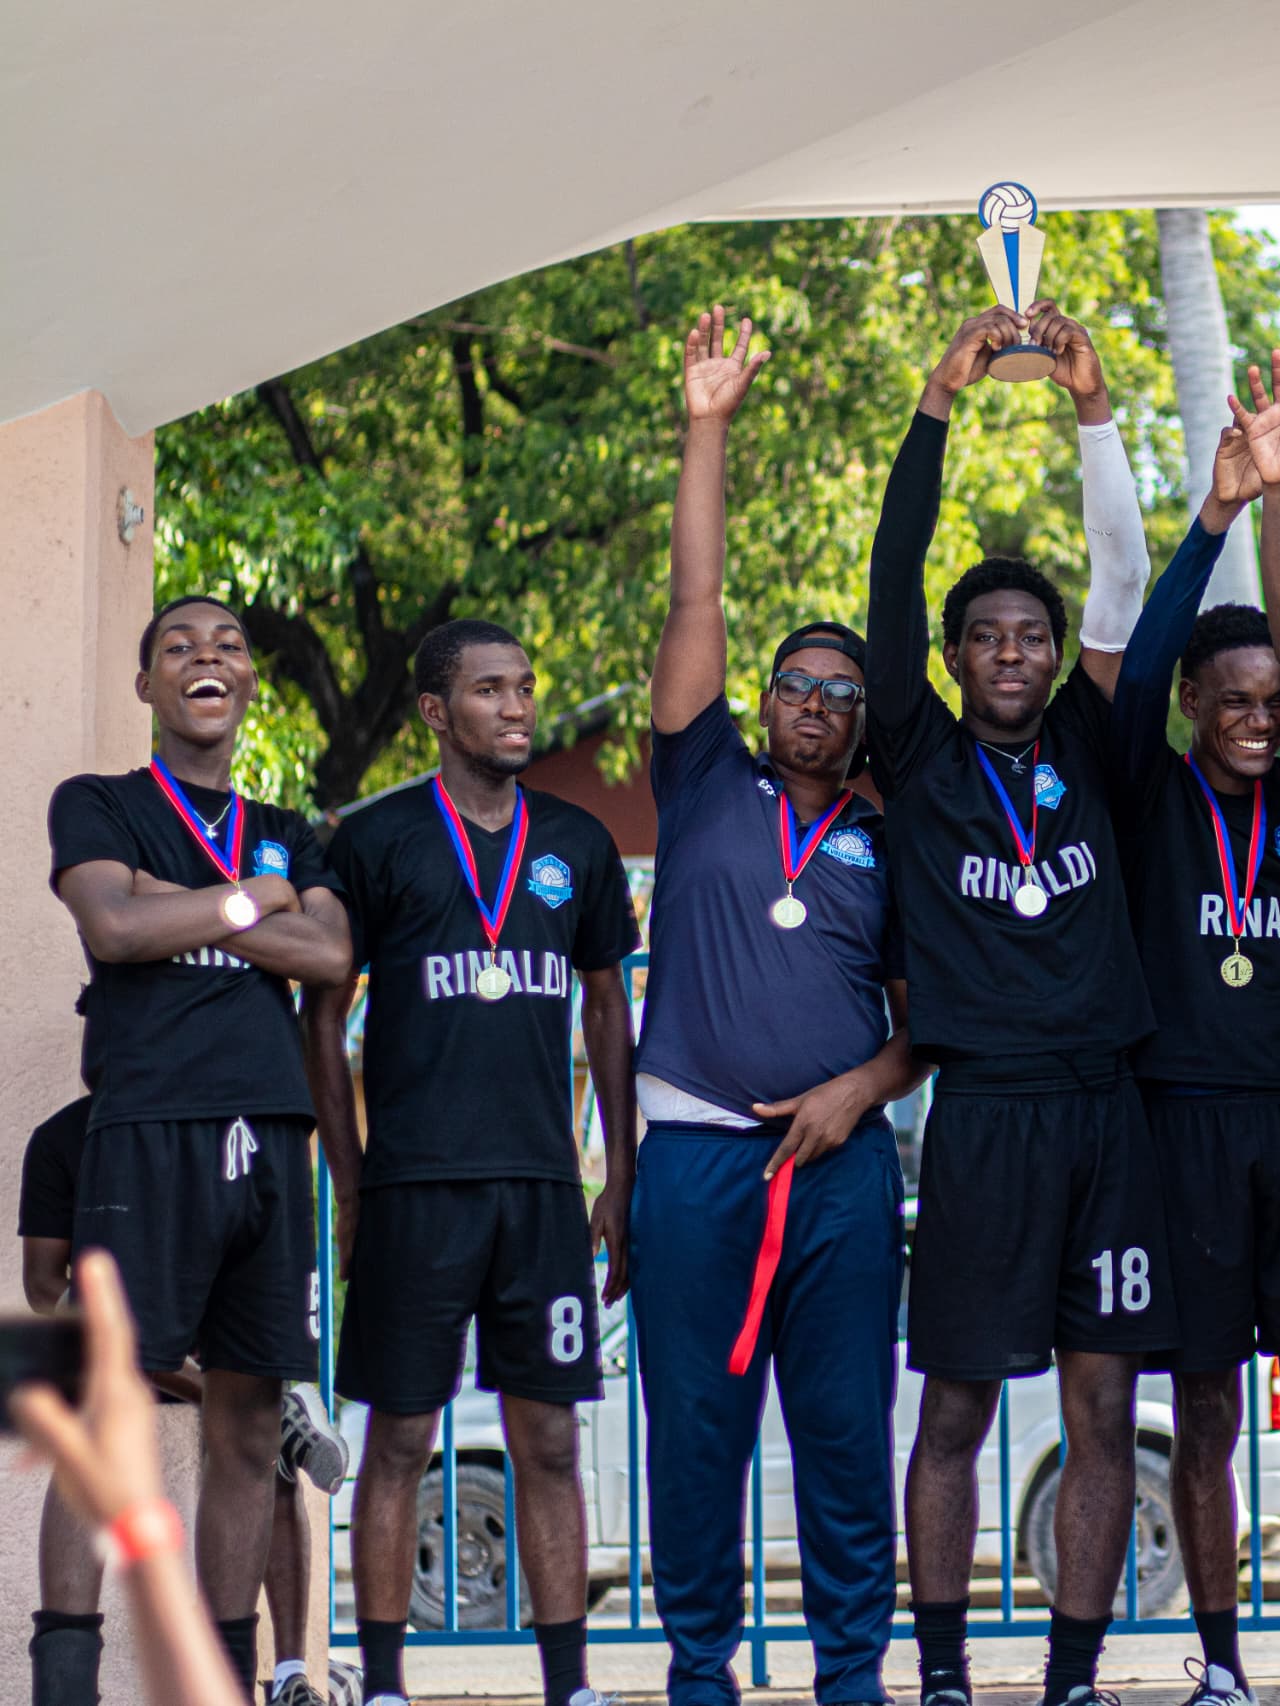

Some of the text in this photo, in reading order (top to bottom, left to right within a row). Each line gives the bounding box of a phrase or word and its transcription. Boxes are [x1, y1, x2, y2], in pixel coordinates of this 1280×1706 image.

[427, 950, 567, 999] RINALDI
[1092, 1247, 1151, 1312] 18
[551, 1296, 583, 1362] 8
